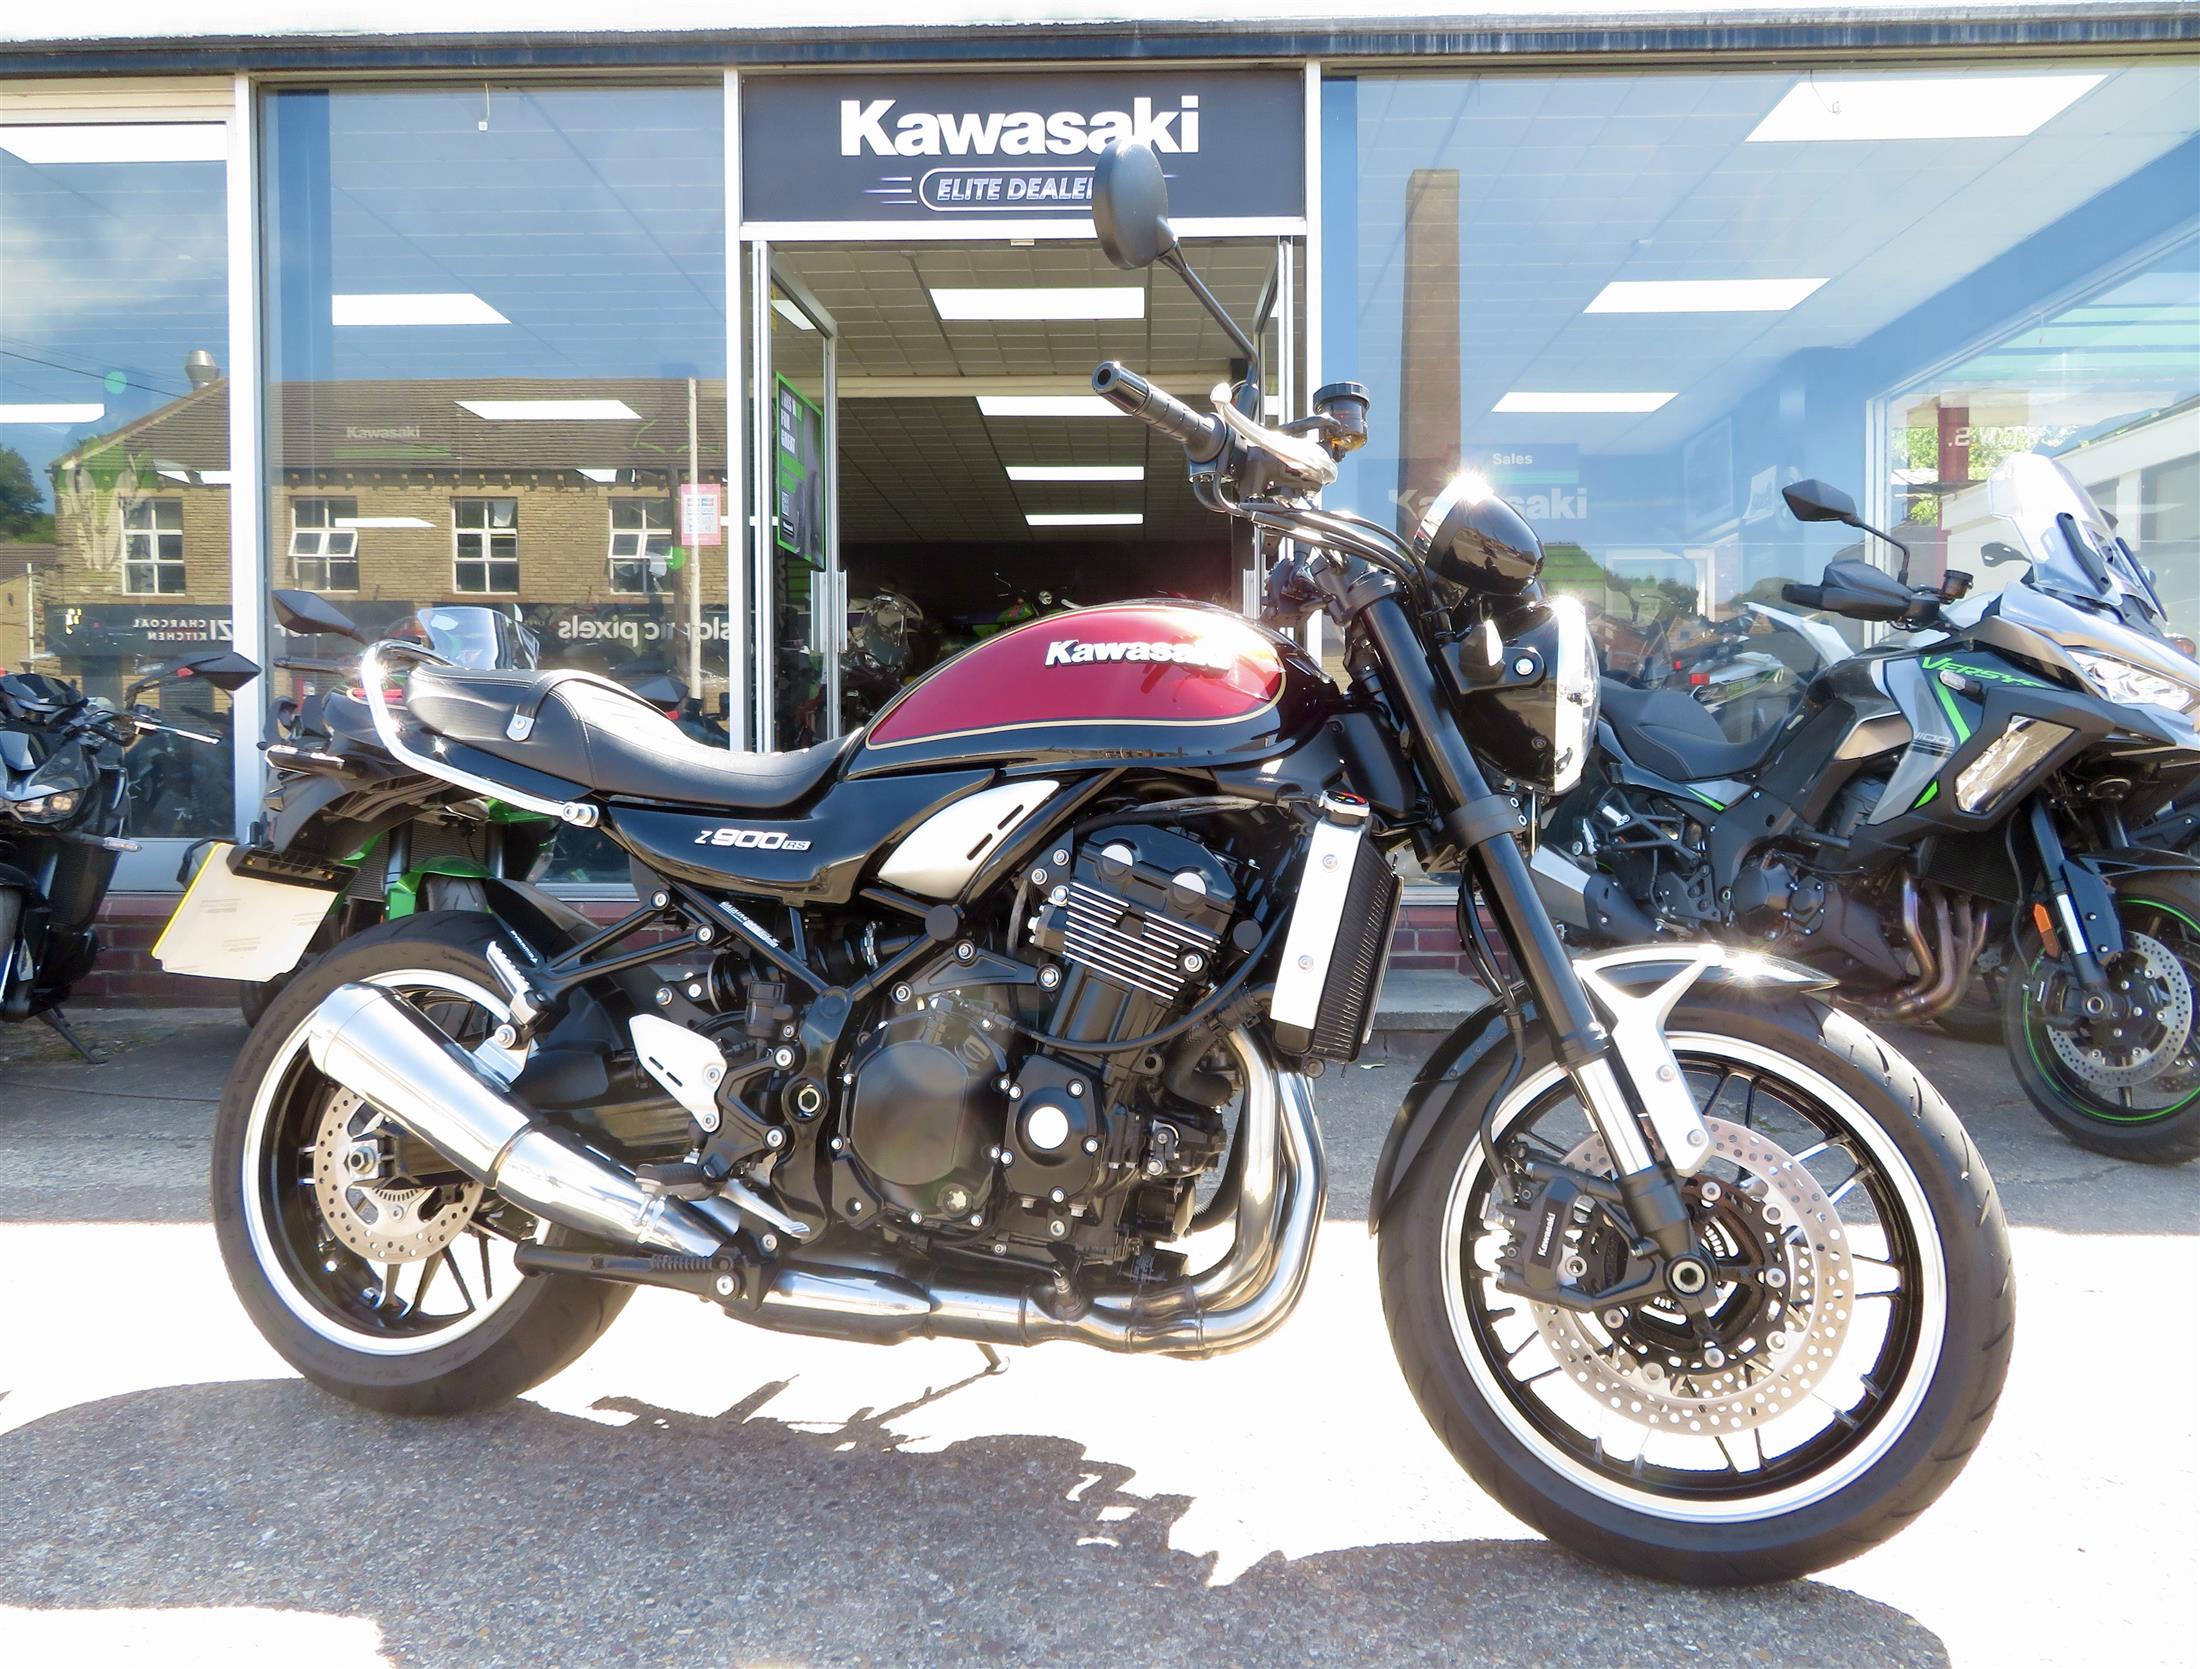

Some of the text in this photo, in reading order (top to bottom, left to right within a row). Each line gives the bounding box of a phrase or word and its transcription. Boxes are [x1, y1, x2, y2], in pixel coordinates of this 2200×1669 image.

[840, 94, 1199, 156] Kawasaki
[936, 177, 1094, 201] ELITE DEALE
[345, 425, 421, 439] Kawasaki
[1492, 452, 1534, 466] Sales
